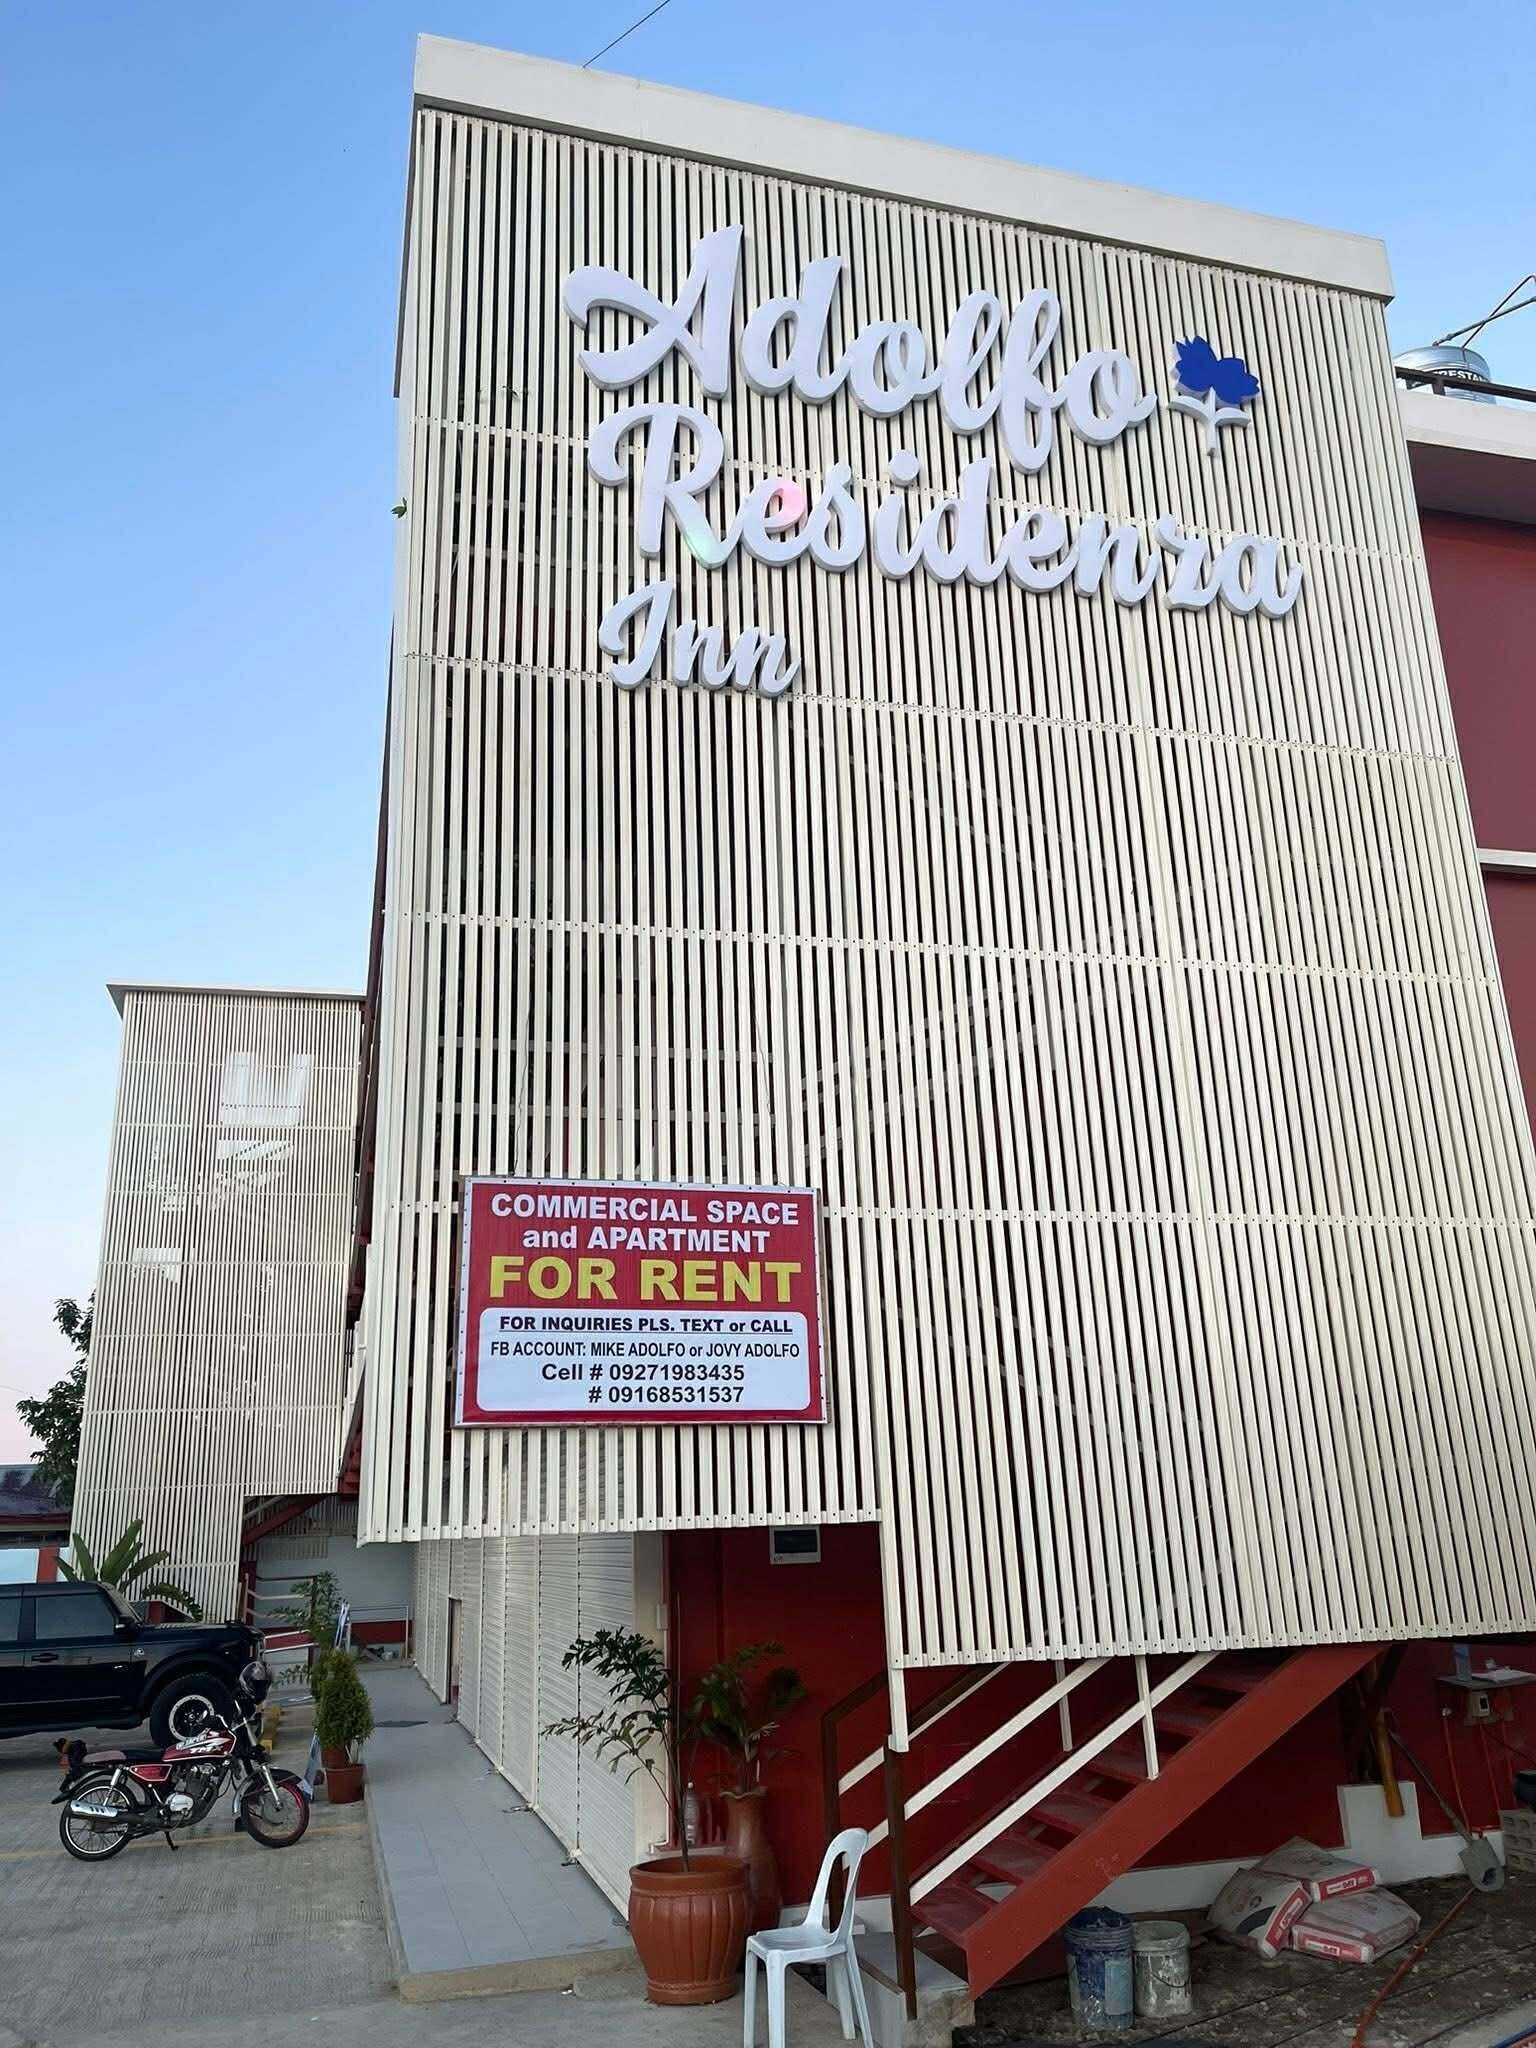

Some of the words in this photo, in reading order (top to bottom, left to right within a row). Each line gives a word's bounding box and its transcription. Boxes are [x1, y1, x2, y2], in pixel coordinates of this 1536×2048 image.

[564, 224, 1157, 475] Adolfo
[587, 401, 1303, 620] Residenza
[599, 578, 800, 698] Inn
[491, 1193, 697, 1223] COMMERCIAL
[706, 1199, 799, 1225] SPACE
[522, 1225, 577, 1249] and
[587, 1226, 770, 1253] APARTMENT
[489, 1255, 618, 1300] FOR
[640, 1258, 802, 1303] RENT
[500, 1316, 536, 1330] FOR
[542, 1316, 633, 1331] INQUIRIES
[638, 1318, 675, 1332] PLS.
[680, 1318, 724, 1332] TEXT
[729, 1322, 746, 1333] or
[750, 1319, 793, 1333] CALL
[491, 1341, 509, 1356] FB
[513, 1341, 586, 1357] ACCOUNT:
[591, 1342, 625, 1357] MIKE
[628, 1342, 685, 1357] ADOLFO
[689, 1346, 703, 1357] or
[706, 1343, 741, 1357] JOVY
[745, 1343, 799, 1358] ADOLFO
[541, 1363, 583, 1381] Cell
[589, 1363, 603, 1381] #
[609, 1364, 745, 1381] 09271983435
[588, 1386, 602, 1403] #
[608, 1386, 744, 1403] 09168531537
